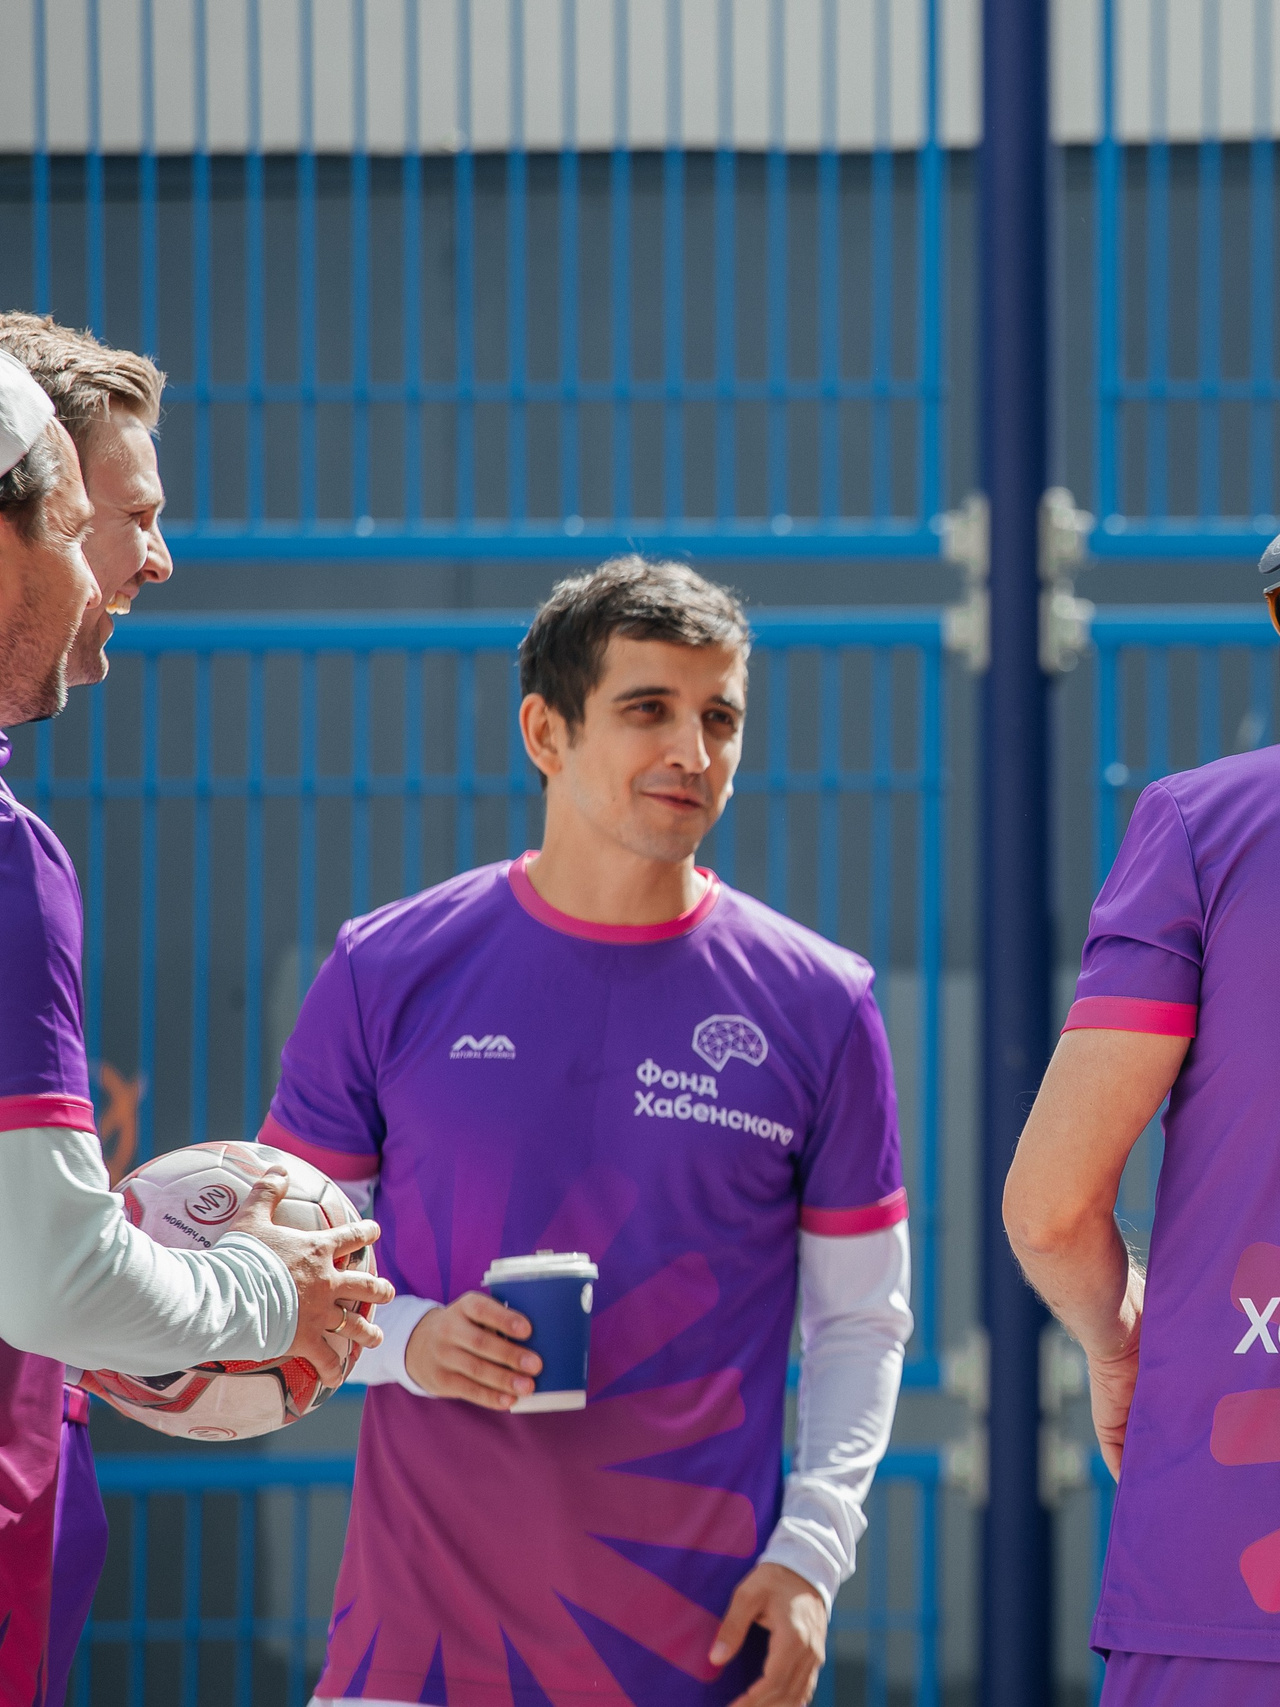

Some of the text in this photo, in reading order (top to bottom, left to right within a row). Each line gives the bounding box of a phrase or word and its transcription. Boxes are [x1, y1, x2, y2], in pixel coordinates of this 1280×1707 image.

[636, 1058, 719, 1099] Фонд
[634, 1090, 794, 1146] Хабенского
[162, 1212, 212, 1249] МОЙМЯЧ.РФ
